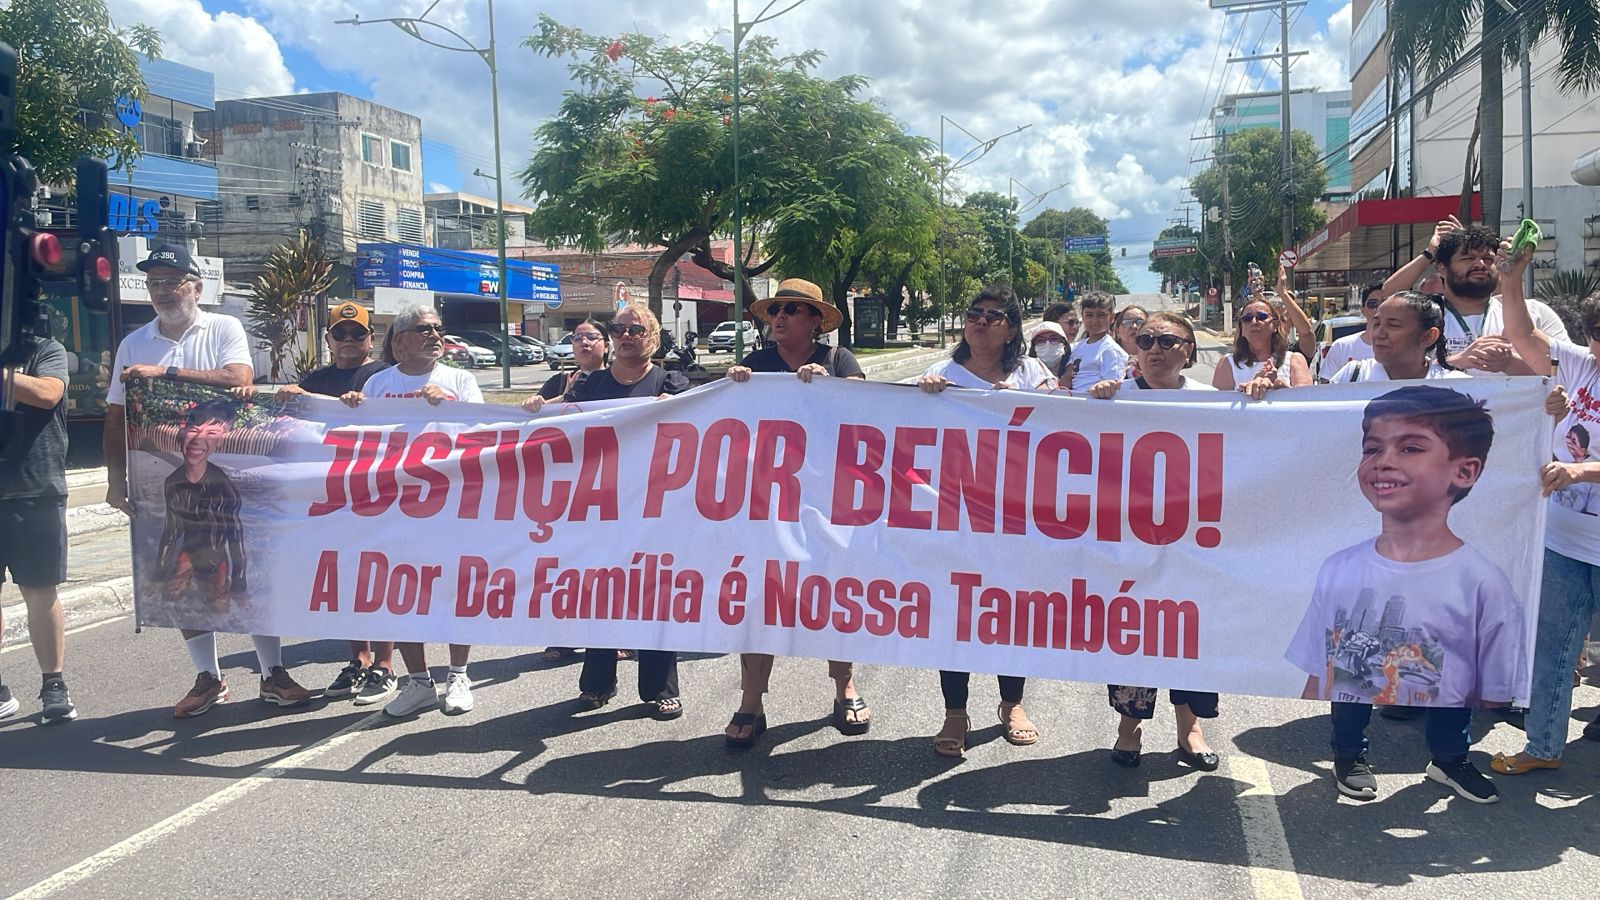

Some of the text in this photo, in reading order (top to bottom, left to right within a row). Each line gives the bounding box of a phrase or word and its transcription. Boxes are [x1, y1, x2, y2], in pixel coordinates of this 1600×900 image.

[402, 248, 420, 258] VENDE
[402, 270, 425, 279] COMPRA
[402, 280, 429, 290] FINANCIA
[308, 406, 1223, 548] JUSTIÇA POR BENÍCIO!
[309, 550, 1199, 660] A Dor Da Família é Nossa Também
